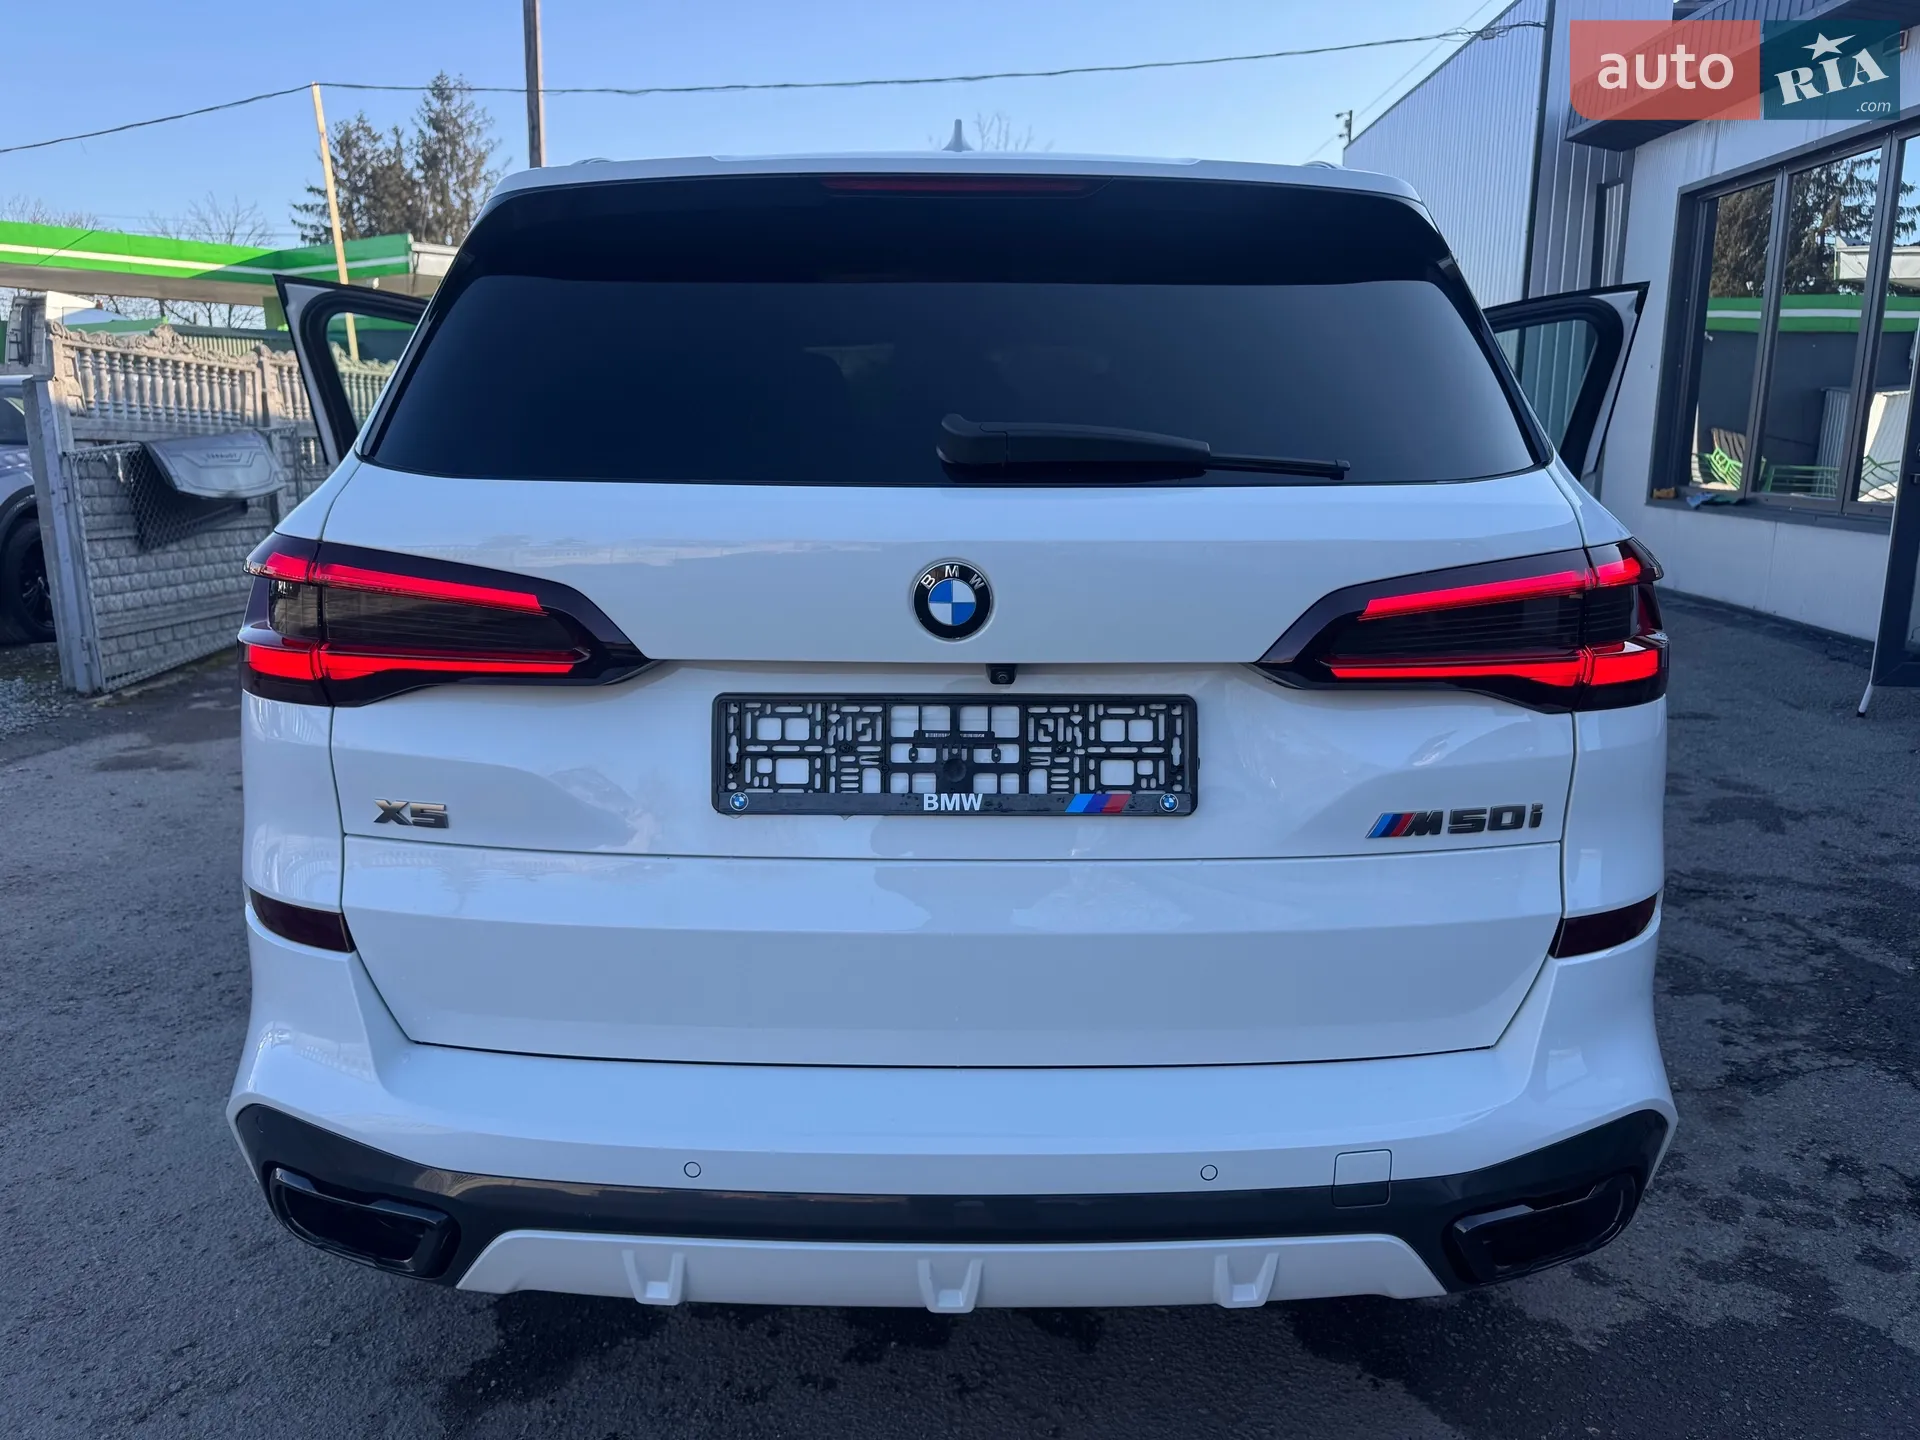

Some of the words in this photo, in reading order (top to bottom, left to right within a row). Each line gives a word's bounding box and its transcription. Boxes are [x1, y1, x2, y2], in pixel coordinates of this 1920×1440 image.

[921, 565, 985, 590] BMW
[373, 799, 449, 829] X5
[923, 793, 984, 812] BMW
